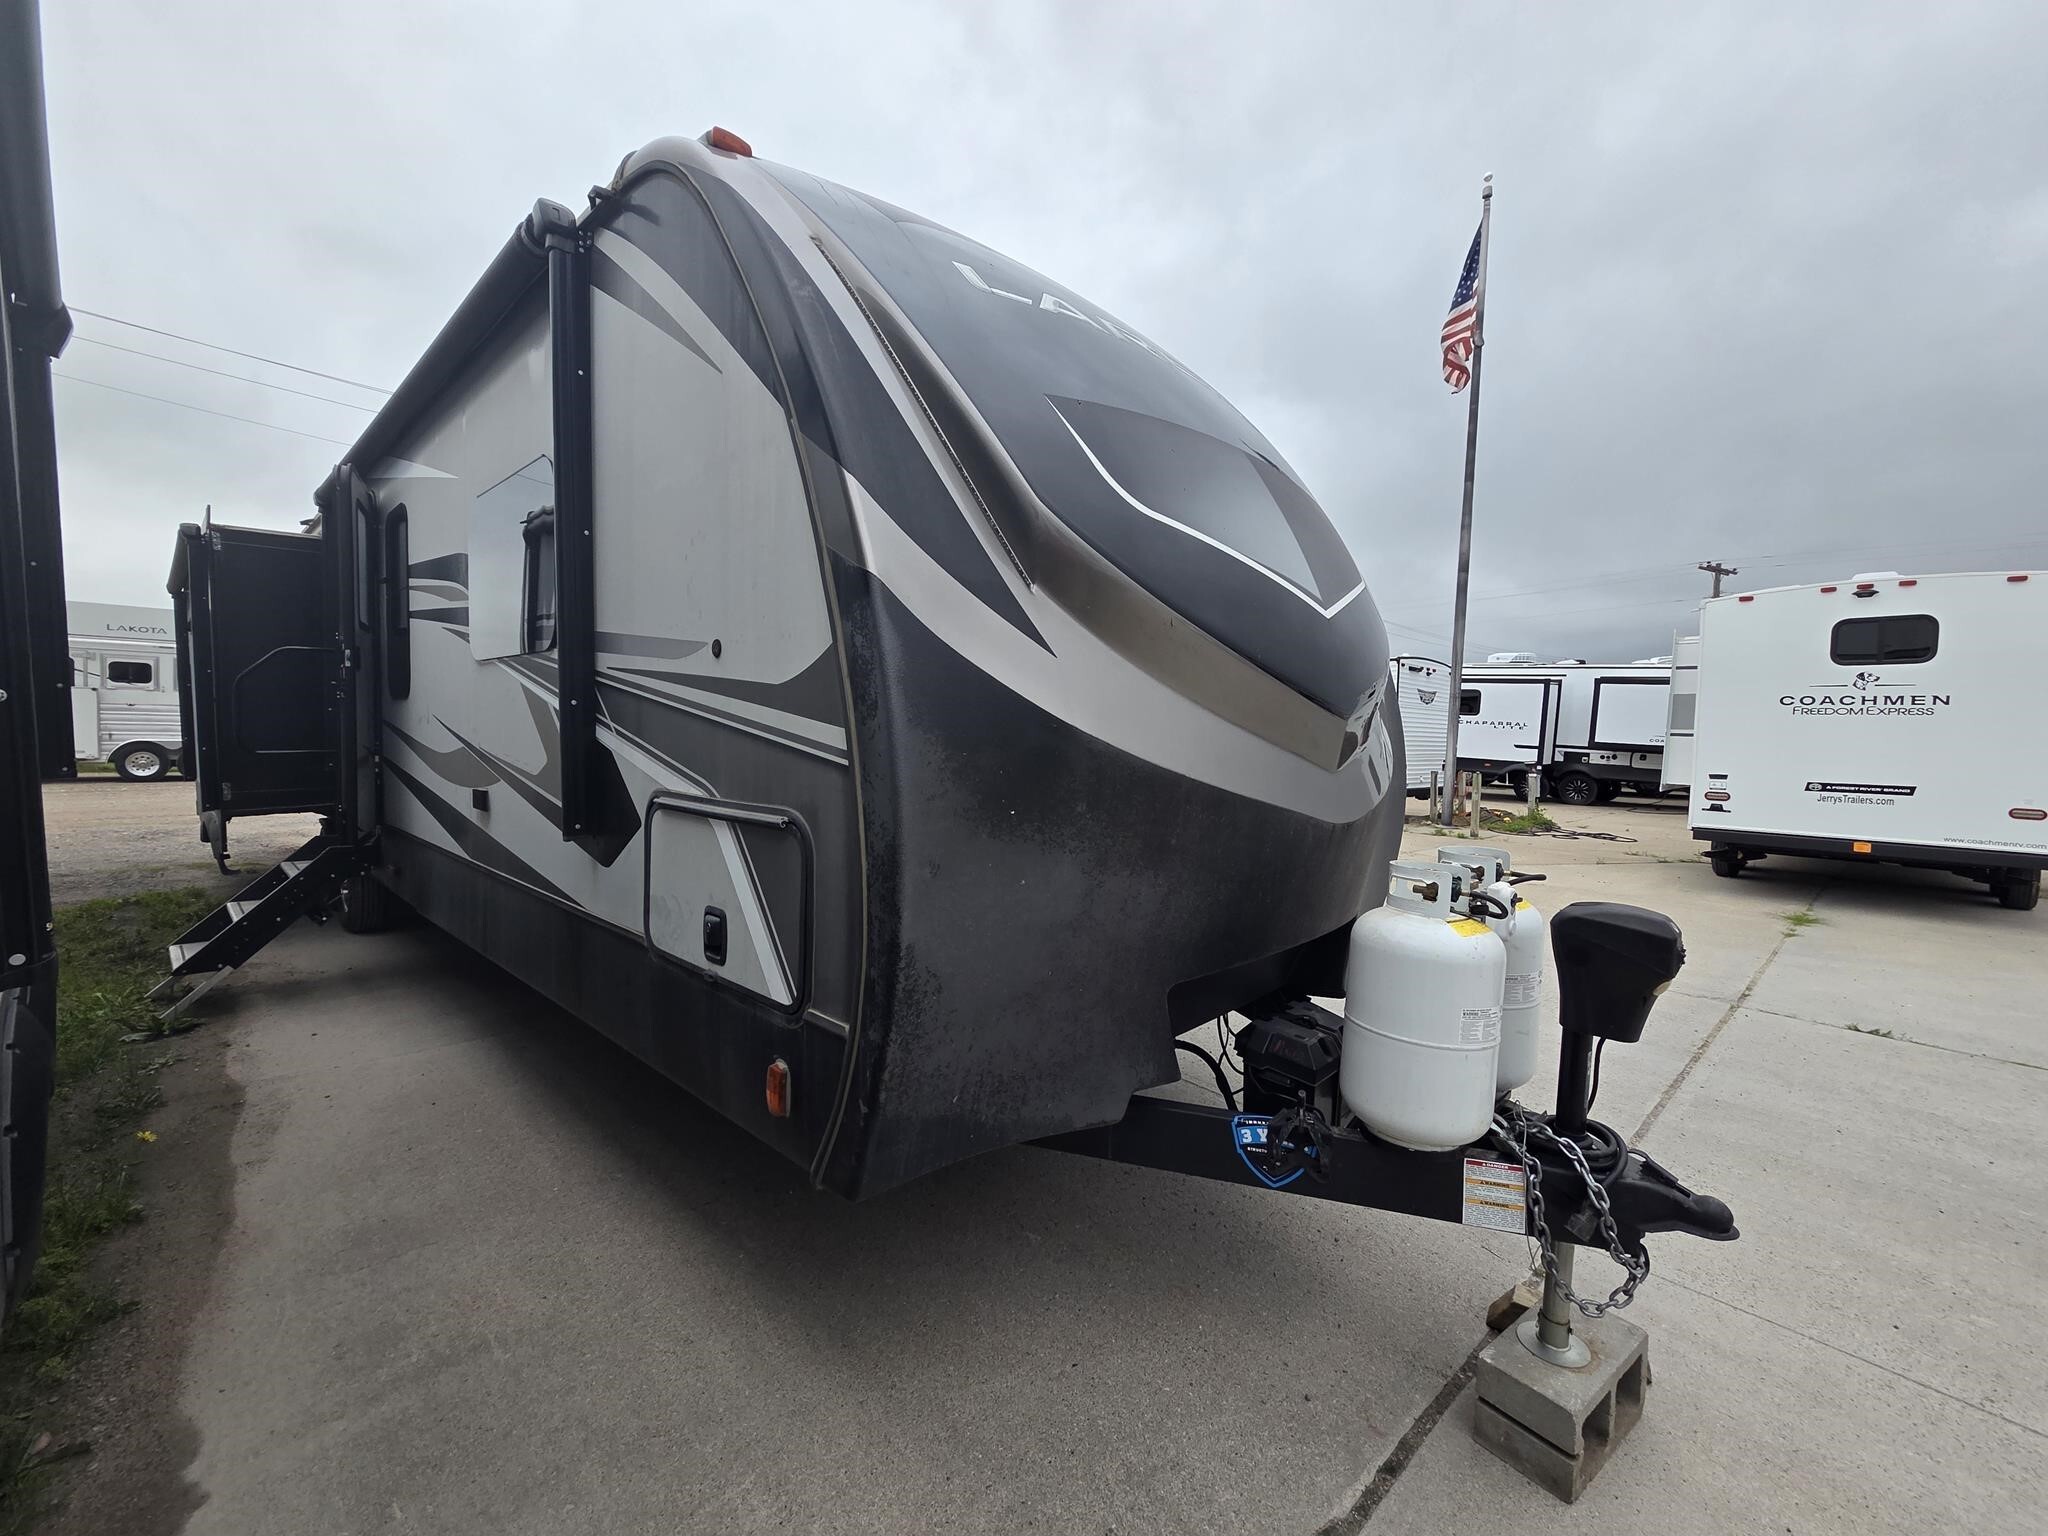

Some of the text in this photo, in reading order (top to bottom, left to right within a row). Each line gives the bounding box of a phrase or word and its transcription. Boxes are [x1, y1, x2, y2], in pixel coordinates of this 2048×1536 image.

[106, 623, 168, 635] LAKOTA
[1779, 695, 1951, 706] COACHMEN
[1458, 719, 1529, 728] CHAPARRAL
[1817, 793, 1895, 806] JerrysTrailers.com
[1943, 837, 2048, 850] www.coachmenrv.com
[1240, 1128, 1253, 1143] 3
